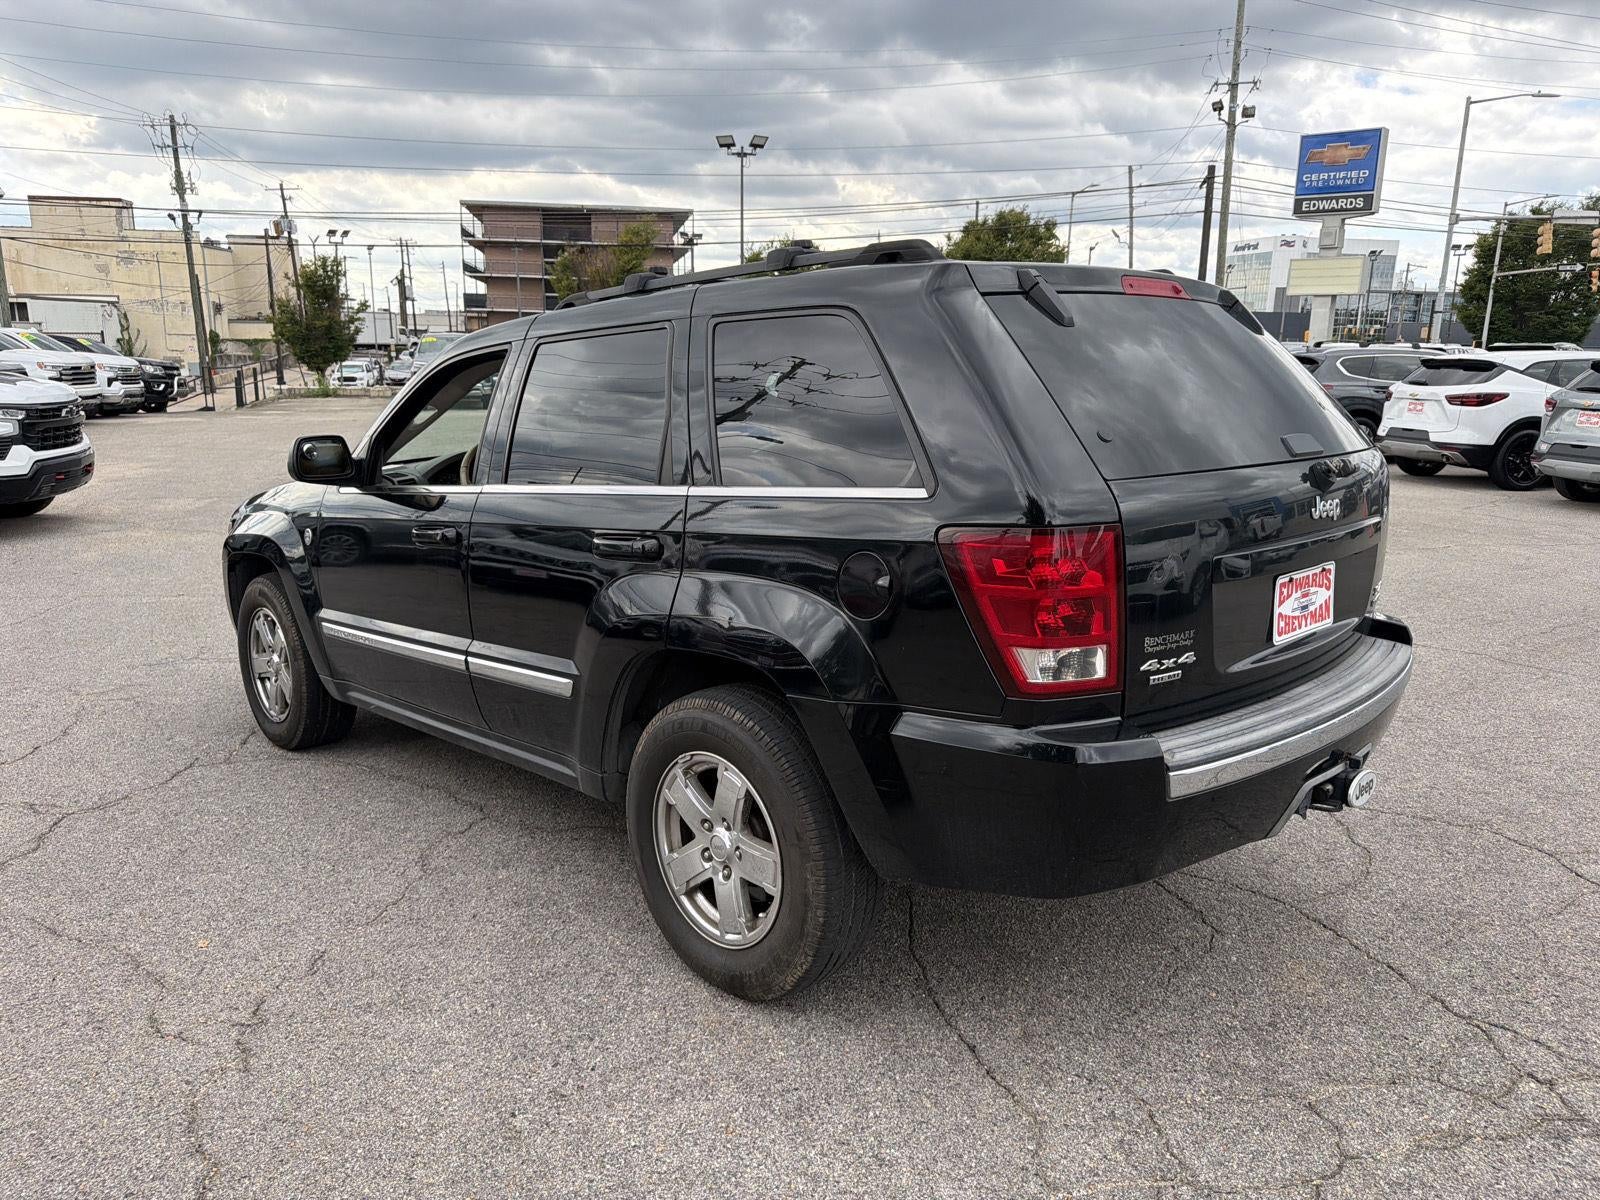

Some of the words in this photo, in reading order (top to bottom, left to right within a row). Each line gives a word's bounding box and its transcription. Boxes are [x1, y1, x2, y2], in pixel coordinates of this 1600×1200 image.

[1302, 169, 1369, 181] CERTIFIED
[1305, 178, 1365, 187] PRE-OWNED
[1302, 197, 1364, 211] EDWARDS
[1311, 496, 1340, 520] Jeep
[1277, 567, 1332, 608] EDWARDS
[1277, 596, 1331, 637] CHEVYMAN
[1144, 629, 1195, 647] BENCHMARK
[1355, 778, 1374, 800] Jeep
